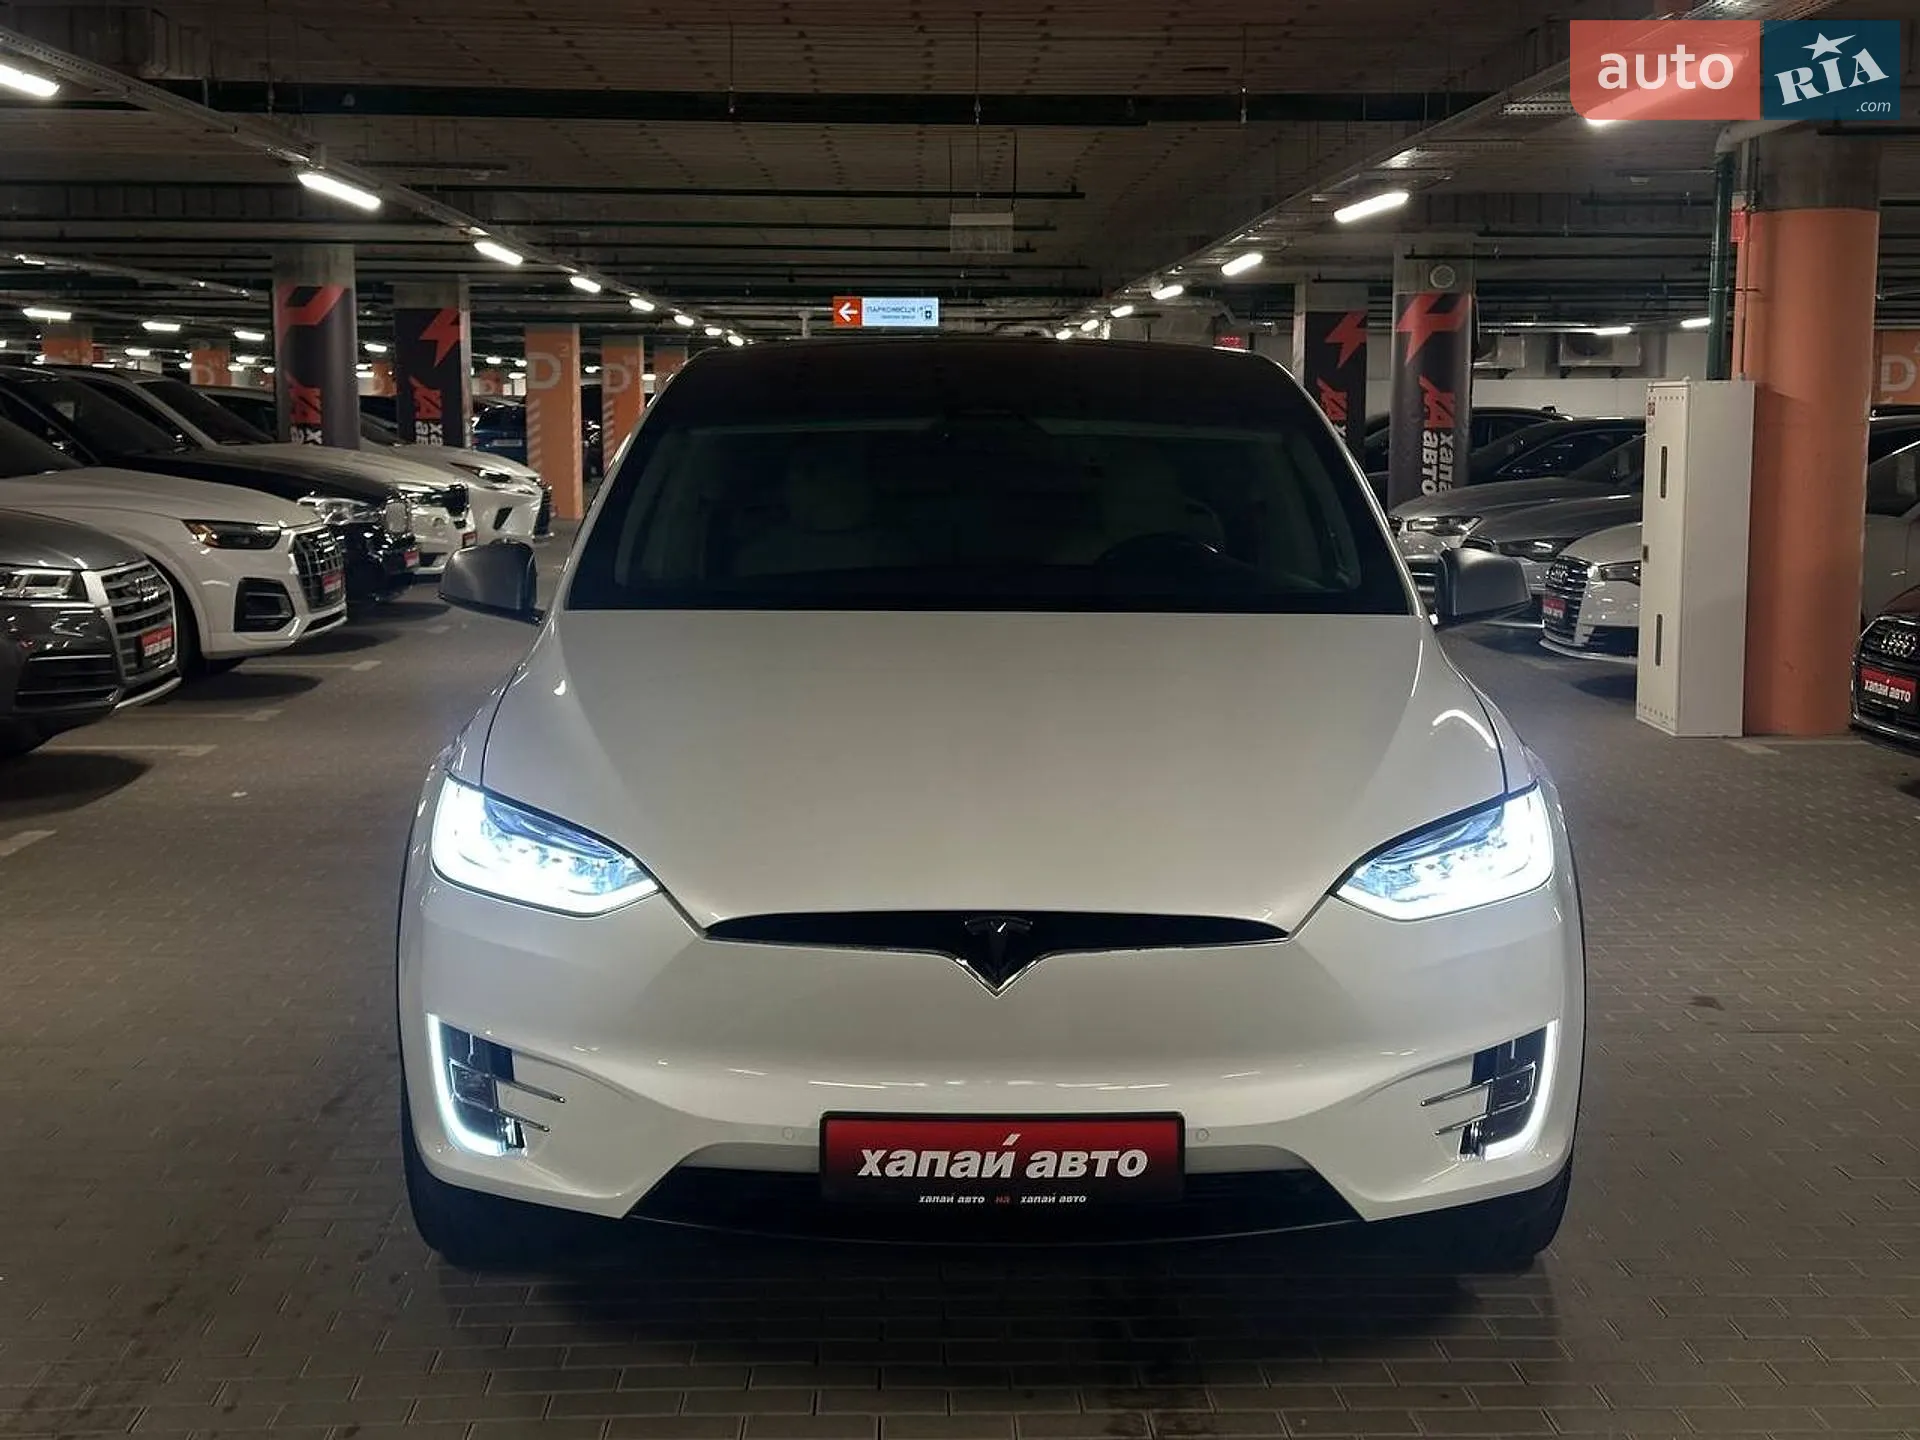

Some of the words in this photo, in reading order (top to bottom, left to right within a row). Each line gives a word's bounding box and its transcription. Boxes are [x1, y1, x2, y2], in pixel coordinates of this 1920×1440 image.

[1421, 430, 1438, 496] авто
[857, 1133, 1021, 1178] хапай
[1025, 1149, 1148, 1178] авто
[957, 1196, 985, 1204] авто
